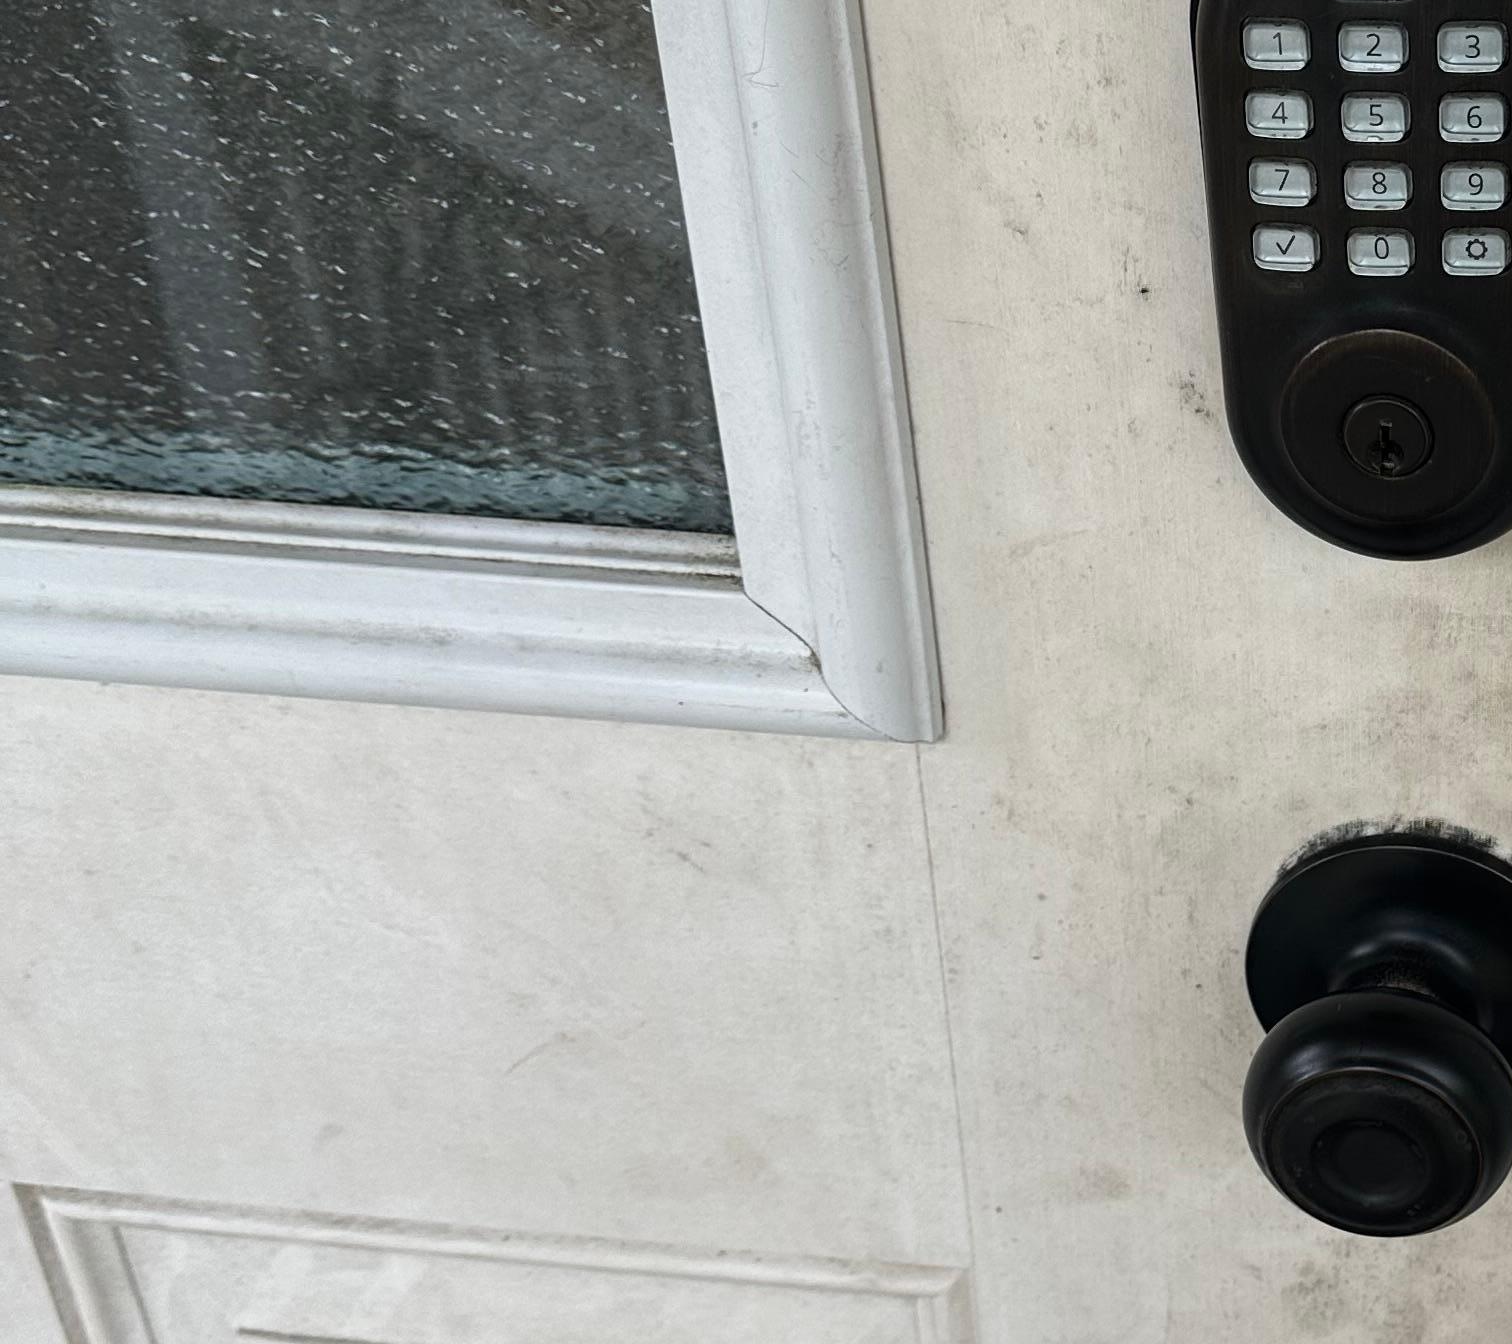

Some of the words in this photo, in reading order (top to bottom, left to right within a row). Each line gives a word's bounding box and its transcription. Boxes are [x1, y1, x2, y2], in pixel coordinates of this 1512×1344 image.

[1271, 31, 1285, 56] 1
[1365, 33, 1383, 58] 2
[1464, 34, 1481, 59] 3
[1270, 102, 1289, 125] 4
[1368, 104, 1385, 127] 5
[1466, 107, 1483, 129] 6
[1274, 168, 1290, 192] 7
[1371, 172, 1388, 195] 8
[1468, 173, 1485, 196] 9
[1373, 237, 1390, 260] 0
